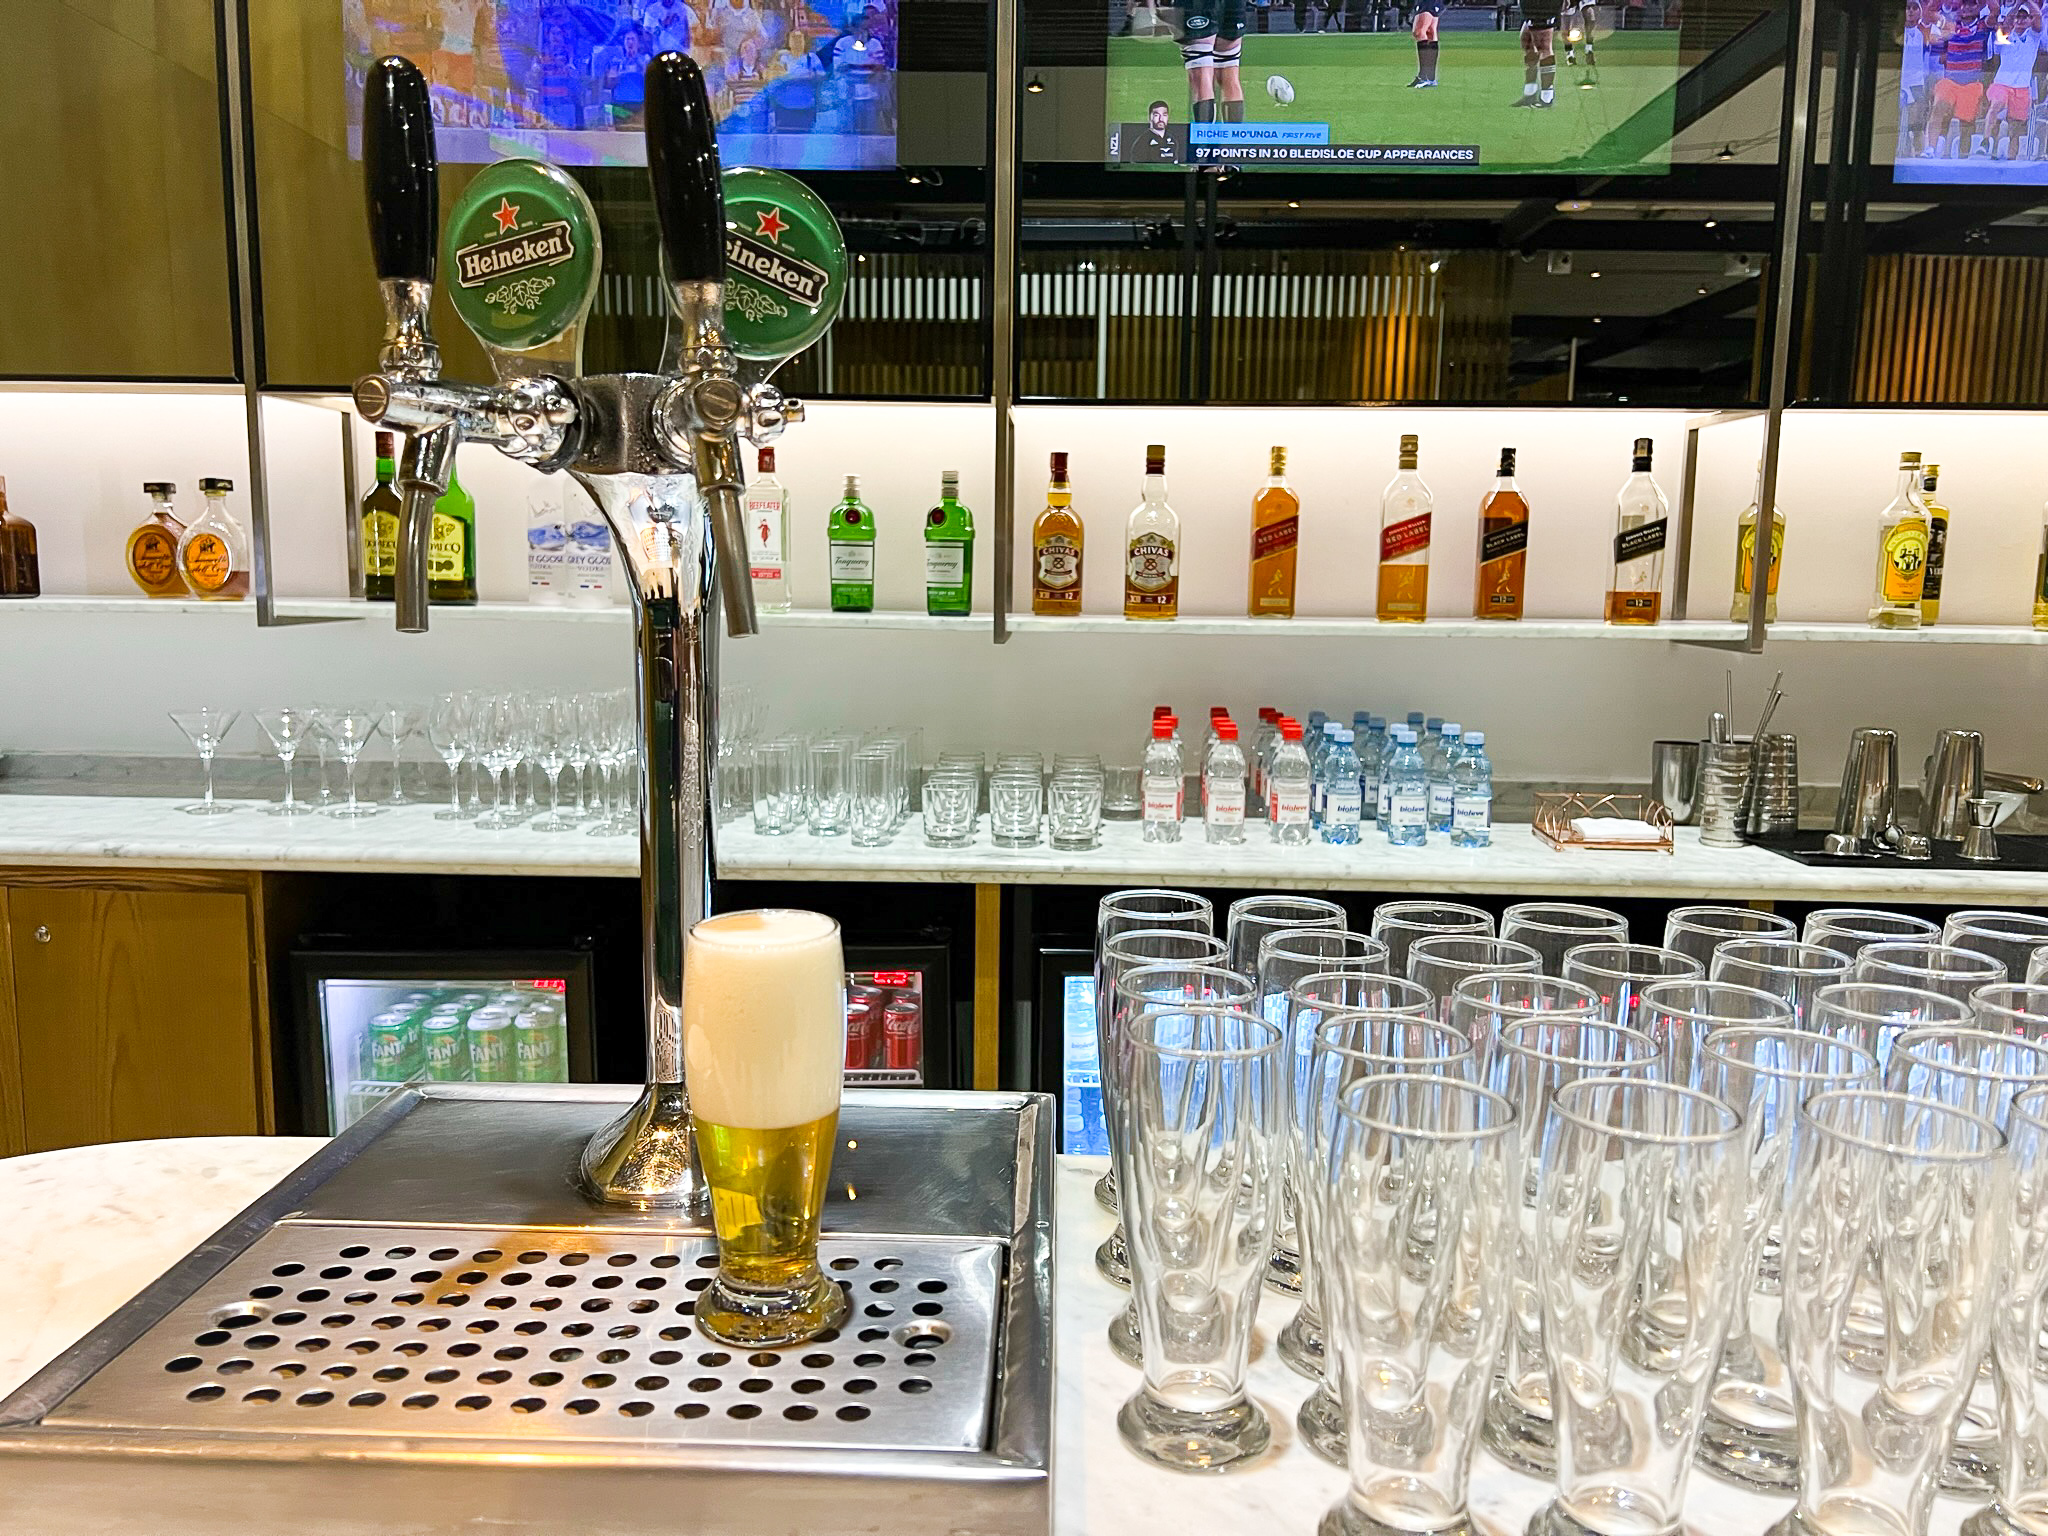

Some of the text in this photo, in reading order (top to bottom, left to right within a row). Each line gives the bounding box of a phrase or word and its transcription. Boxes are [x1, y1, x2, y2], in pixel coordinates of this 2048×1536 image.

[1196, 130, 1229, 139] RICHIE
[1231, 130, 1278, 139] MO'UNGA
[1109, 132, 1119, 155] NZL
[1195, 148, 1474, 160] 97 POINTS IN 10 BLEDISLOE CUP APPEARANCES
[464, 236, 563, 278] Heineken
[1042, 546, 1075, 556] CHIVAS
[1134, 546, 1169, 557] CHIVAS
[1064, 591, 1074, 599] 12
[1157, 595, 1167, 604] 12
